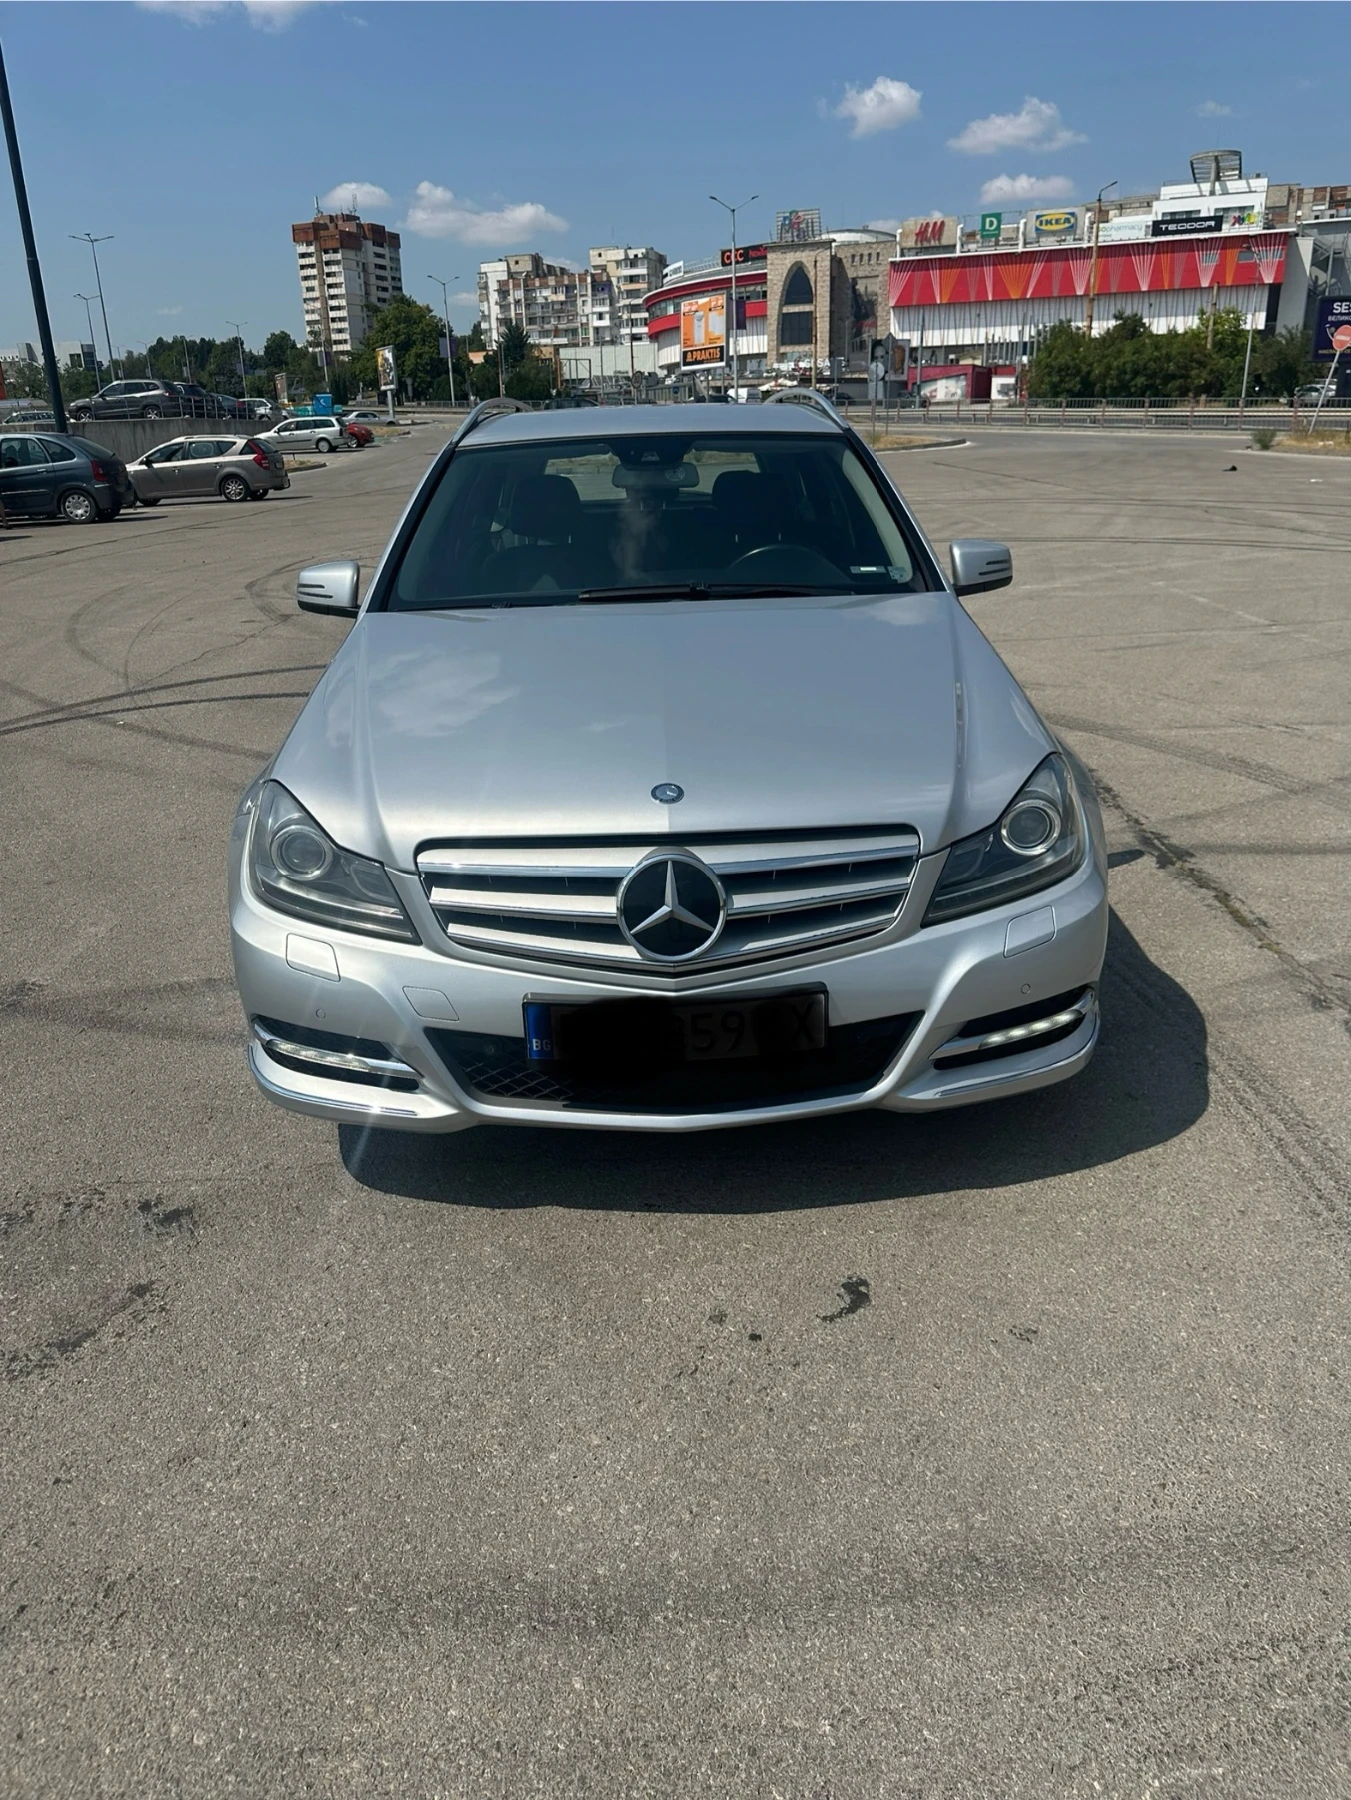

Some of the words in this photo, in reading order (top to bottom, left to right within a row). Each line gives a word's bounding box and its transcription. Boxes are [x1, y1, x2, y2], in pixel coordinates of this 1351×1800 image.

[985, 217, 998, 230] D
[1038, 217, 1071, 227] IKEA
[1160, 220, 1215, 231] TEODOR
[1332, 302, 1351, 313] SE
[693, 348, 720, 361] PRAKTIS
[533, 1039, 551, 1051] BG
